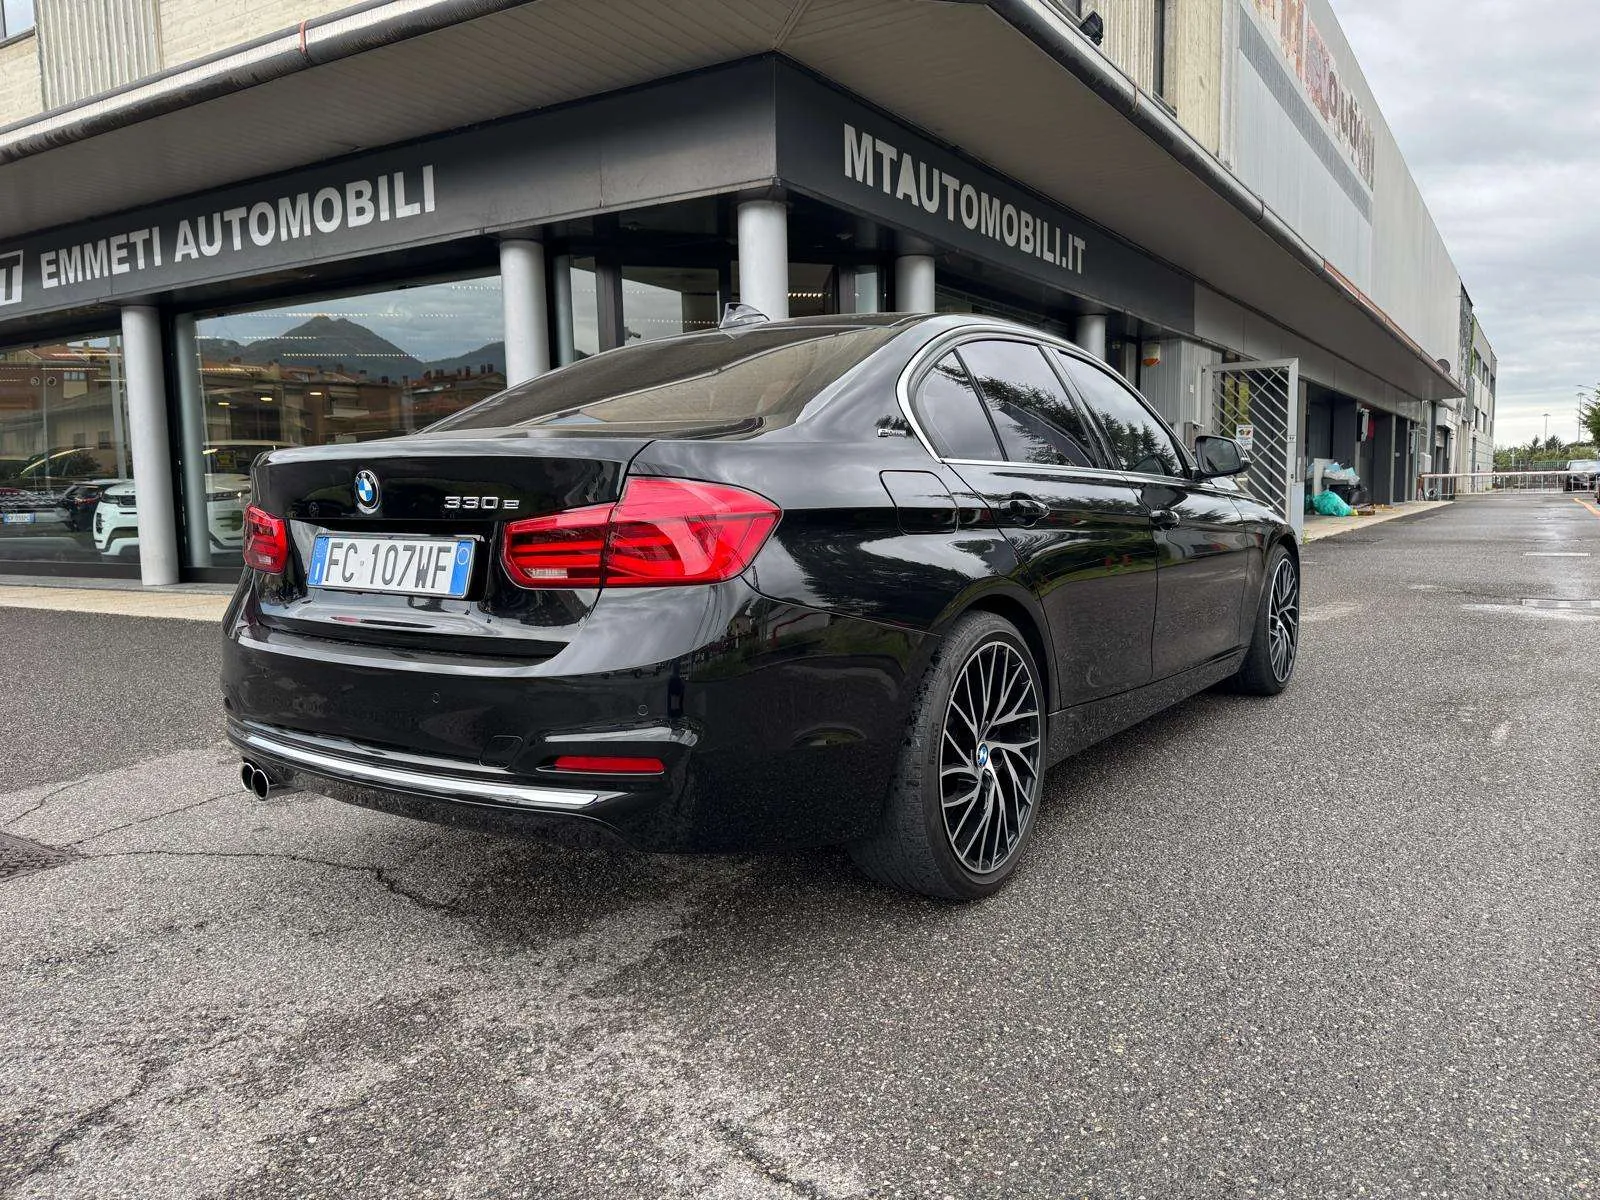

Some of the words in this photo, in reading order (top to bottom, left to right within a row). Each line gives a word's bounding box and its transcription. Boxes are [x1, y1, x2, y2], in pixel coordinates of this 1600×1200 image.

[40, 227, 162, 289] EMMETI
[174, 165, 436, 263] AUTOMOBILI
[843, 122, 1086, 275] MTAUTOMOBILI.IT
[324, 541, 358, 583] FC
[369, 543, 453, 589] 107WF
